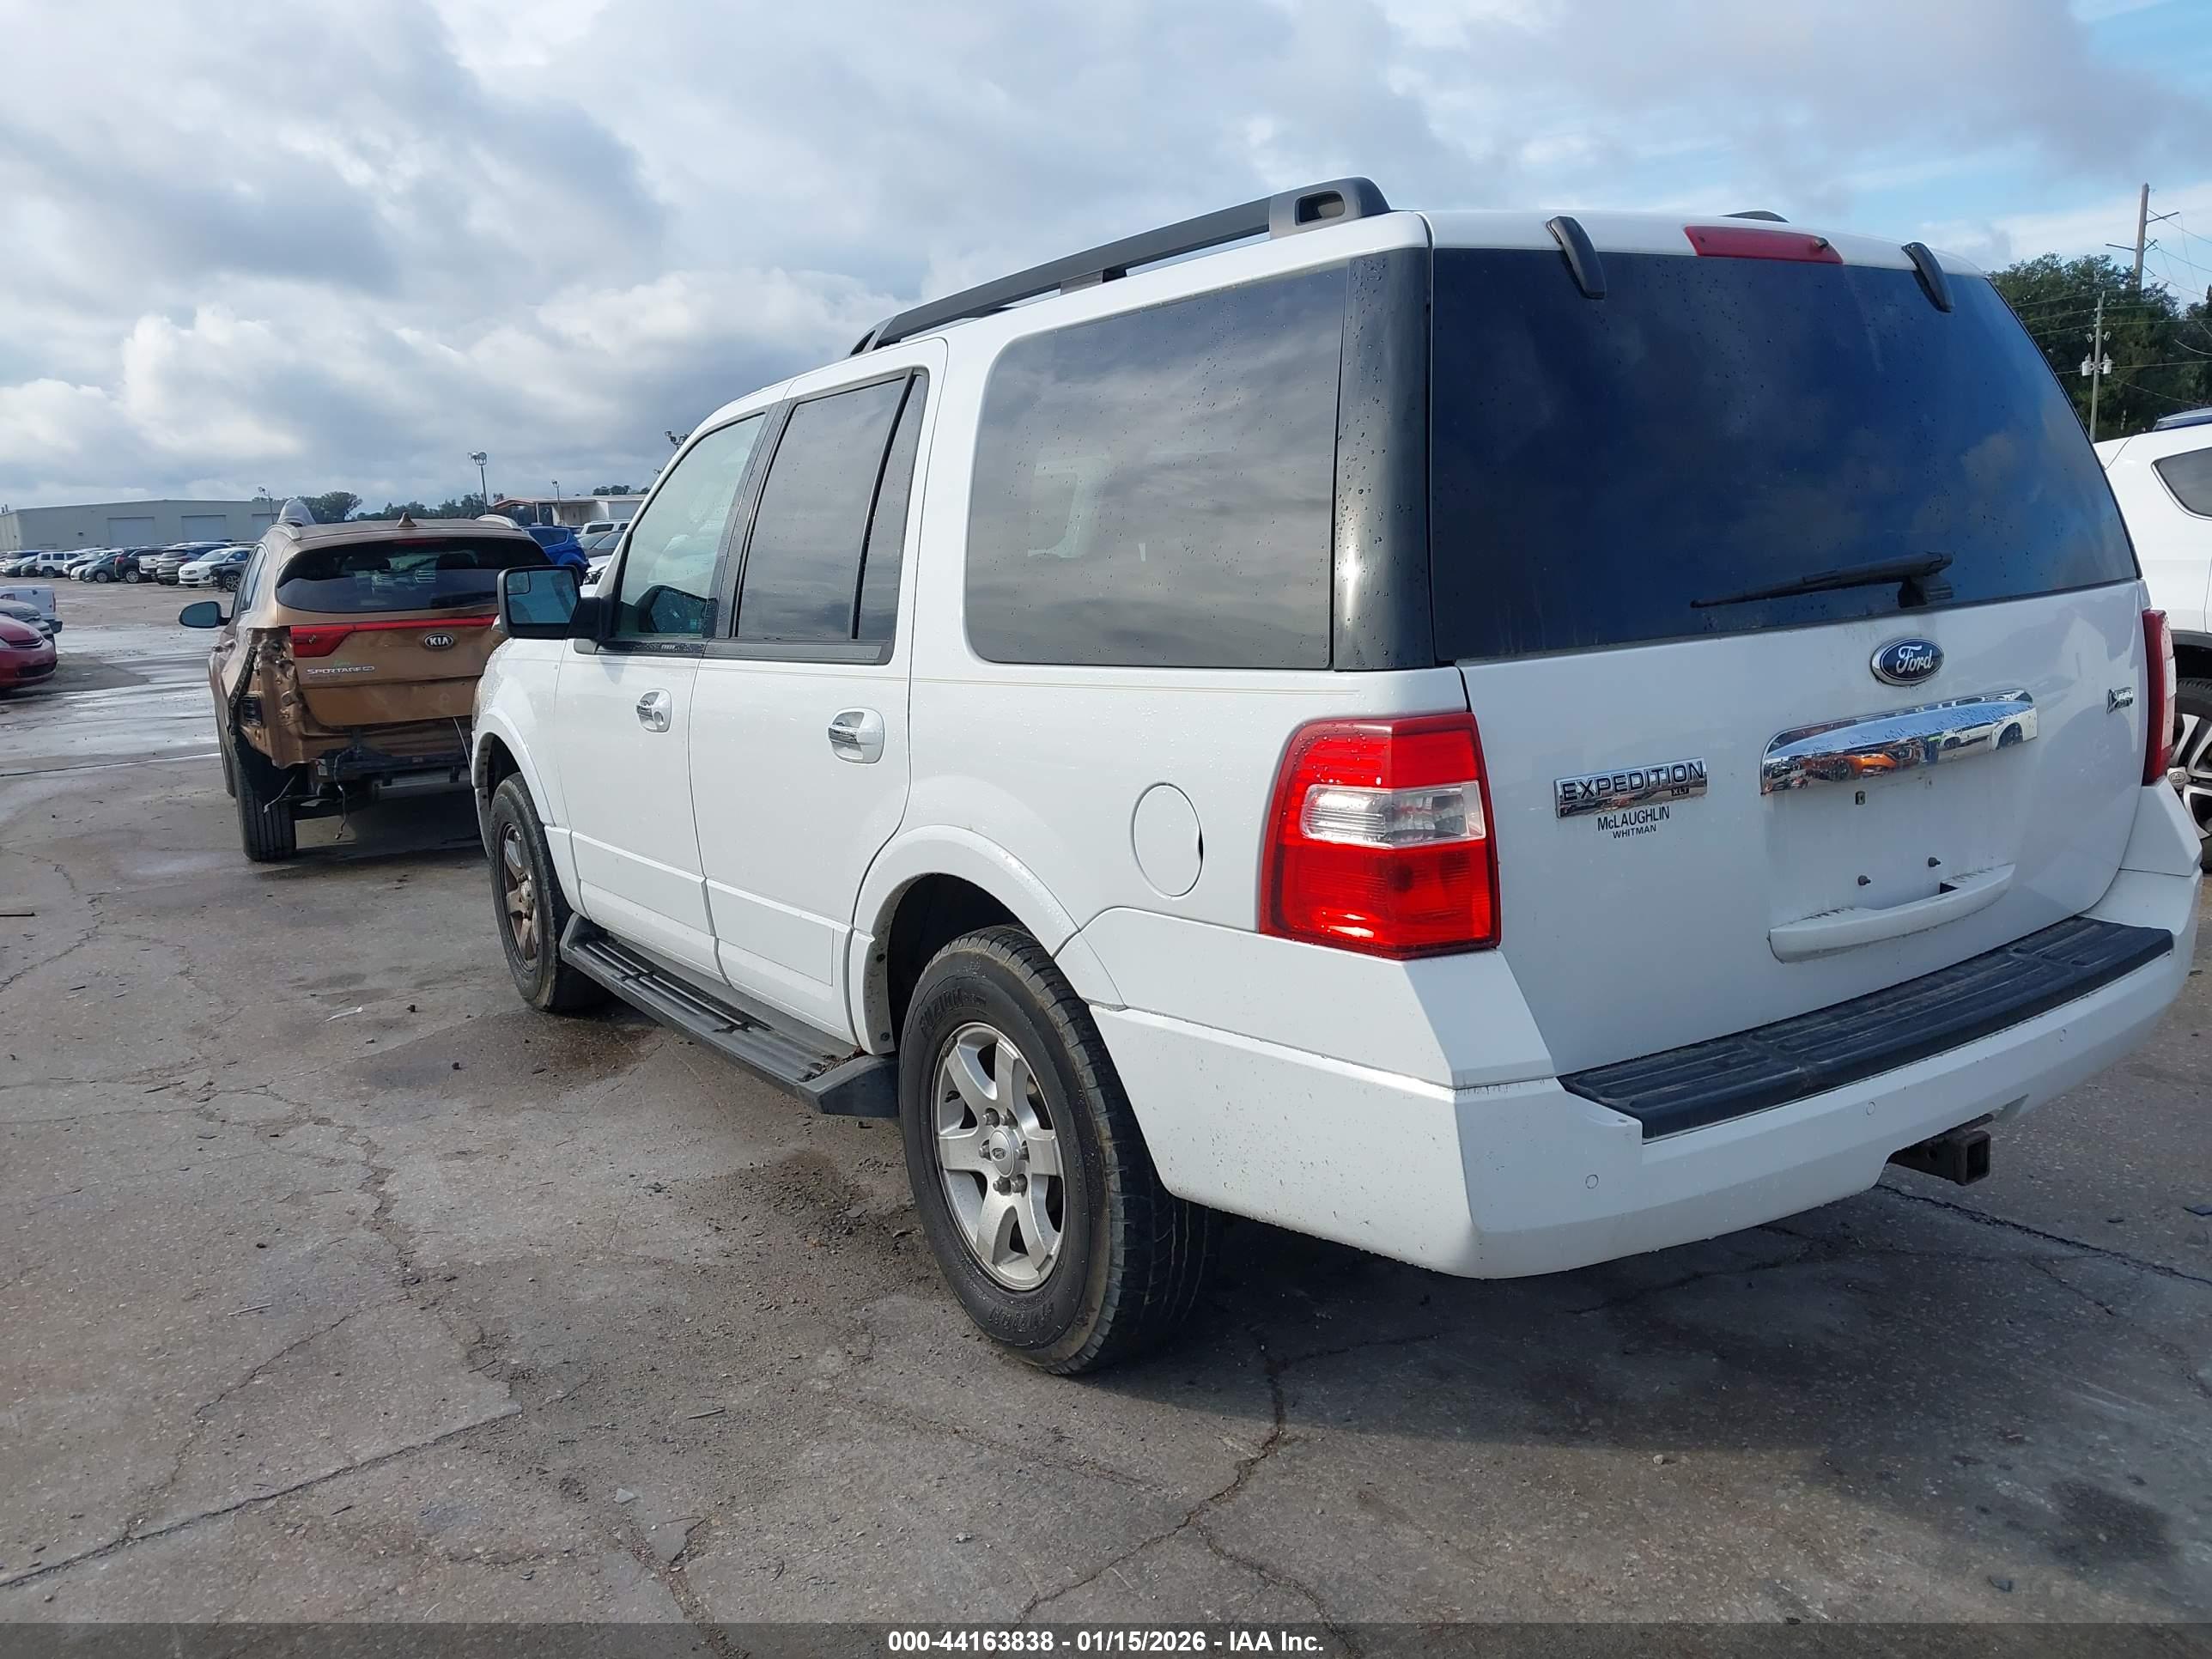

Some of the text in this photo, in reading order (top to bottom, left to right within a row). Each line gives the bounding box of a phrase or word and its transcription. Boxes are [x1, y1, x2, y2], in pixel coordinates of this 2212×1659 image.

[429, 636, 449, 646] KIA
[1896, 645, 1934, 674] Ford
[1562, 760, 1705, 802] EXPEDITION
[1672, 787, 1689, 796] XLT
[1597, 805, 1670, 832] McLAUGHLIN
[1612, 823, 1657, 839] WHITMAN
